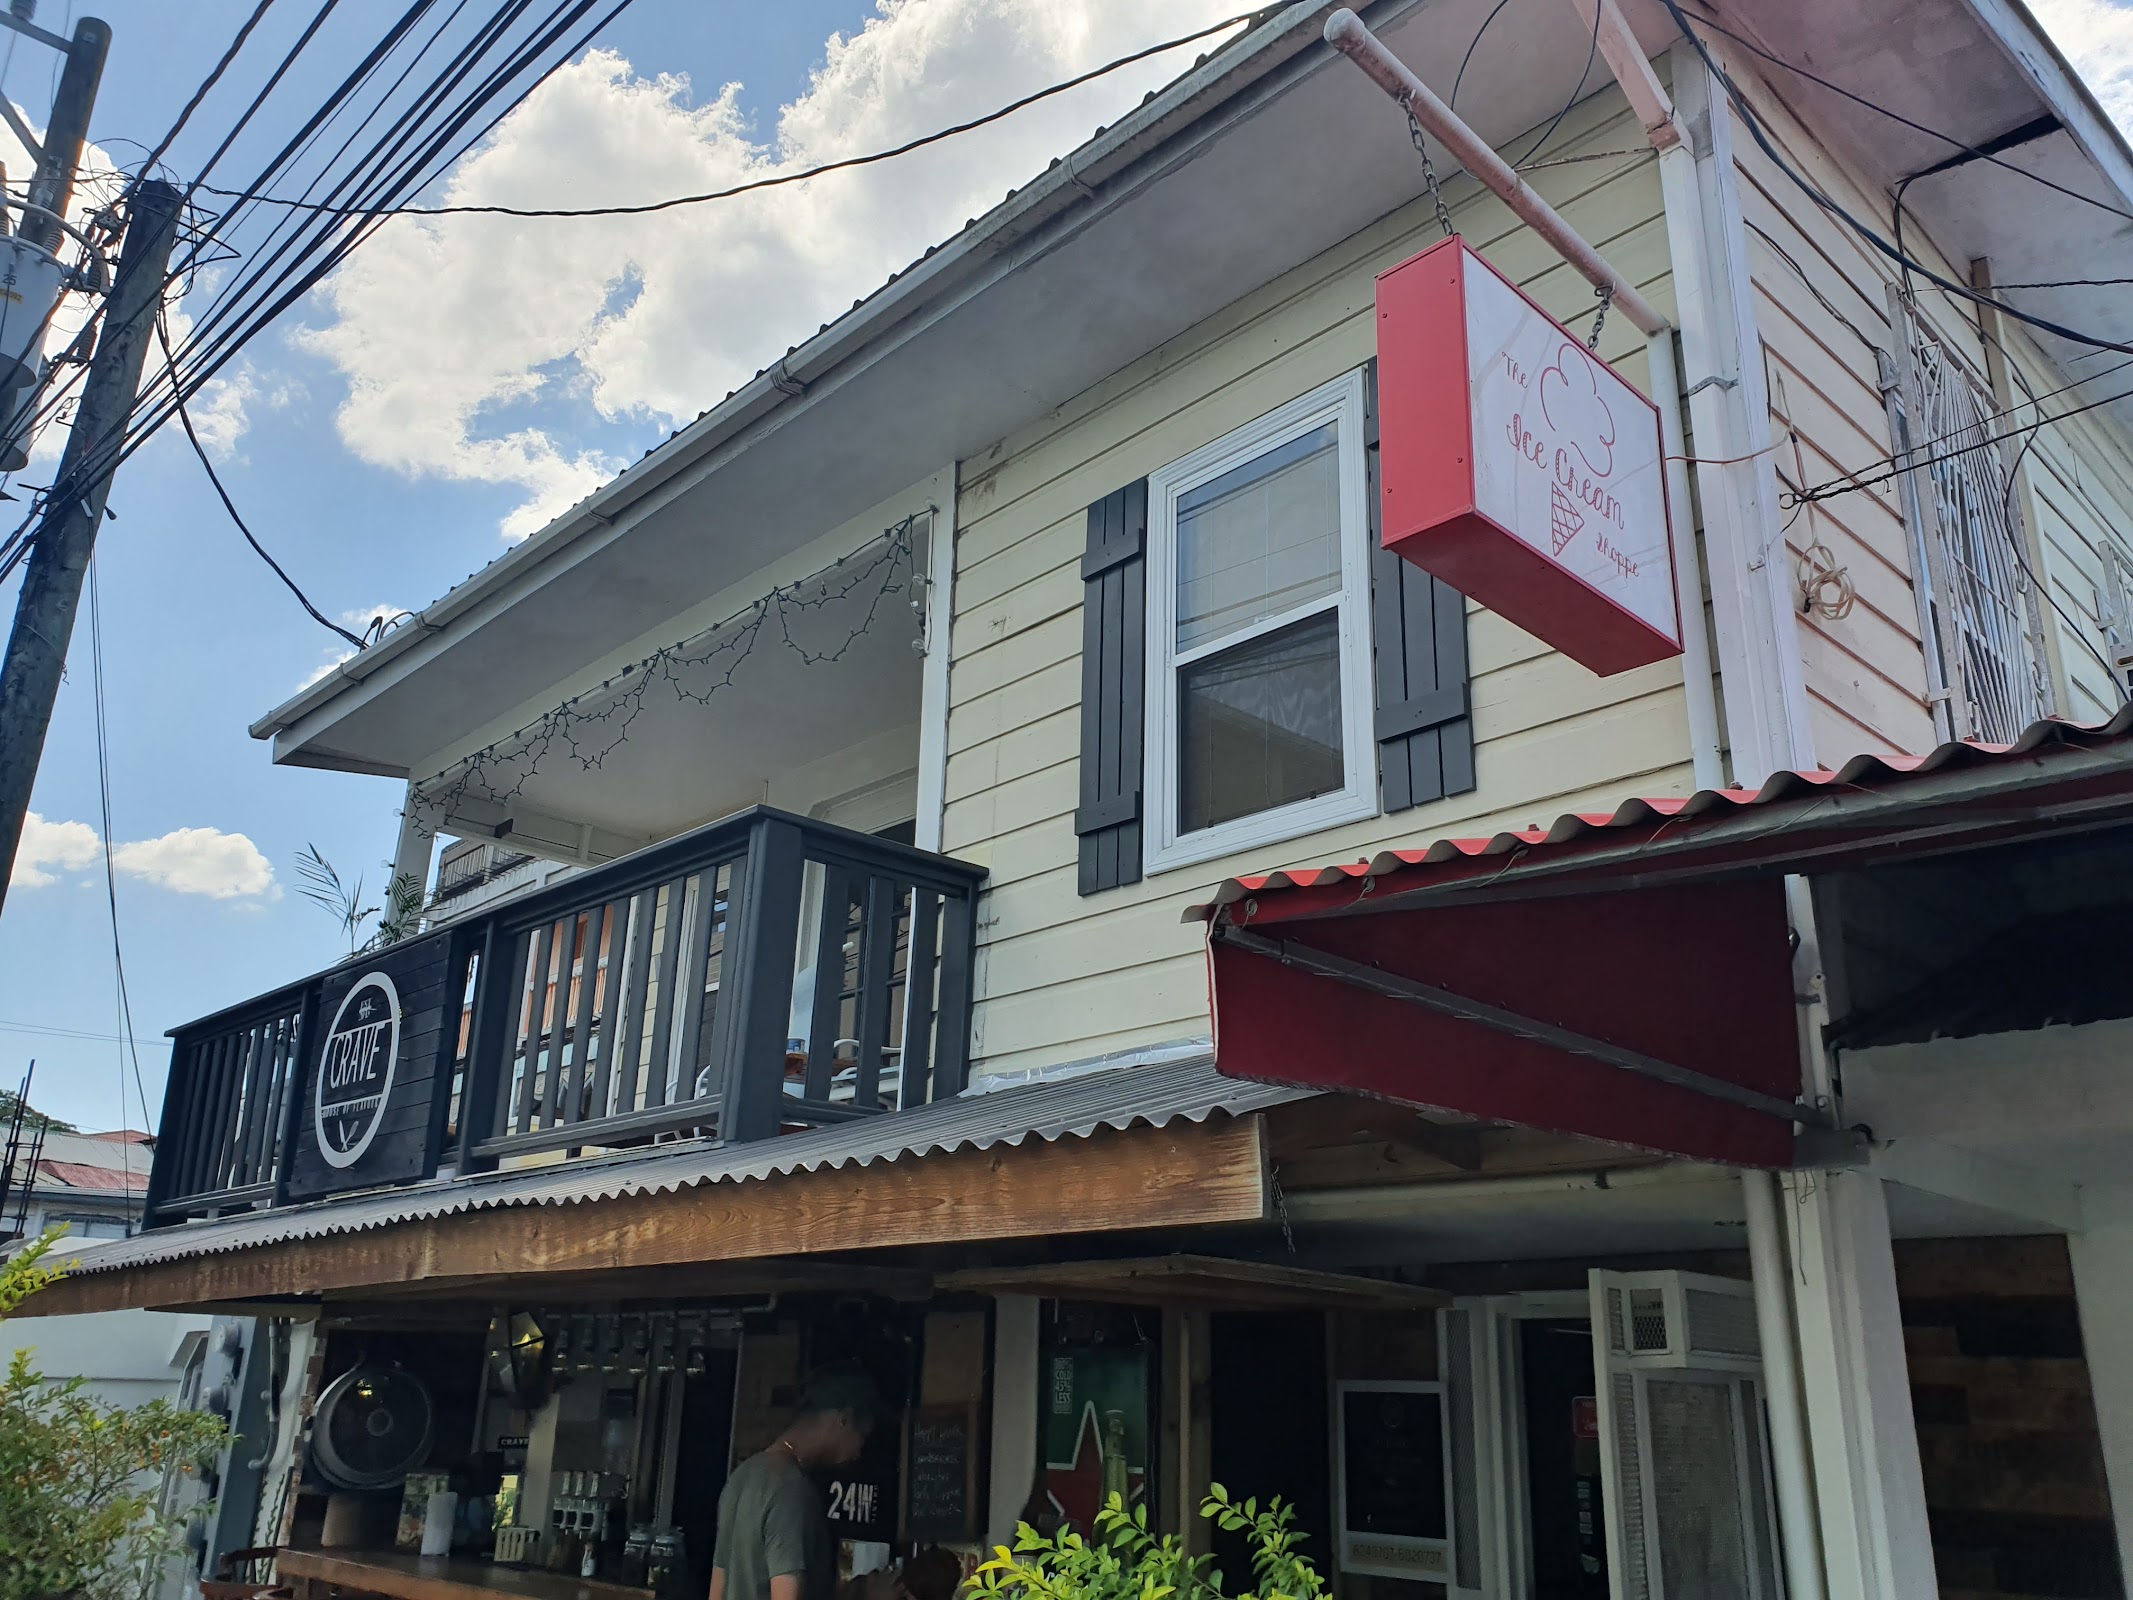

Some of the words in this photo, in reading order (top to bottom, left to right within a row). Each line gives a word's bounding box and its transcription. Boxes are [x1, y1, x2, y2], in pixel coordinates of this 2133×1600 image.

[1501, 351, 1529, 389] The
[1506, 413, 1548, 469] Ice
[1554, 447, 1626, 530] Cream
[1595, 532, 1640, 579] Shoppe
[330, 1023, 386, 1089] CRAVE
[342, 1103, 350, 1115] OF
[1055, 1392, 1071, 1403] LESS
